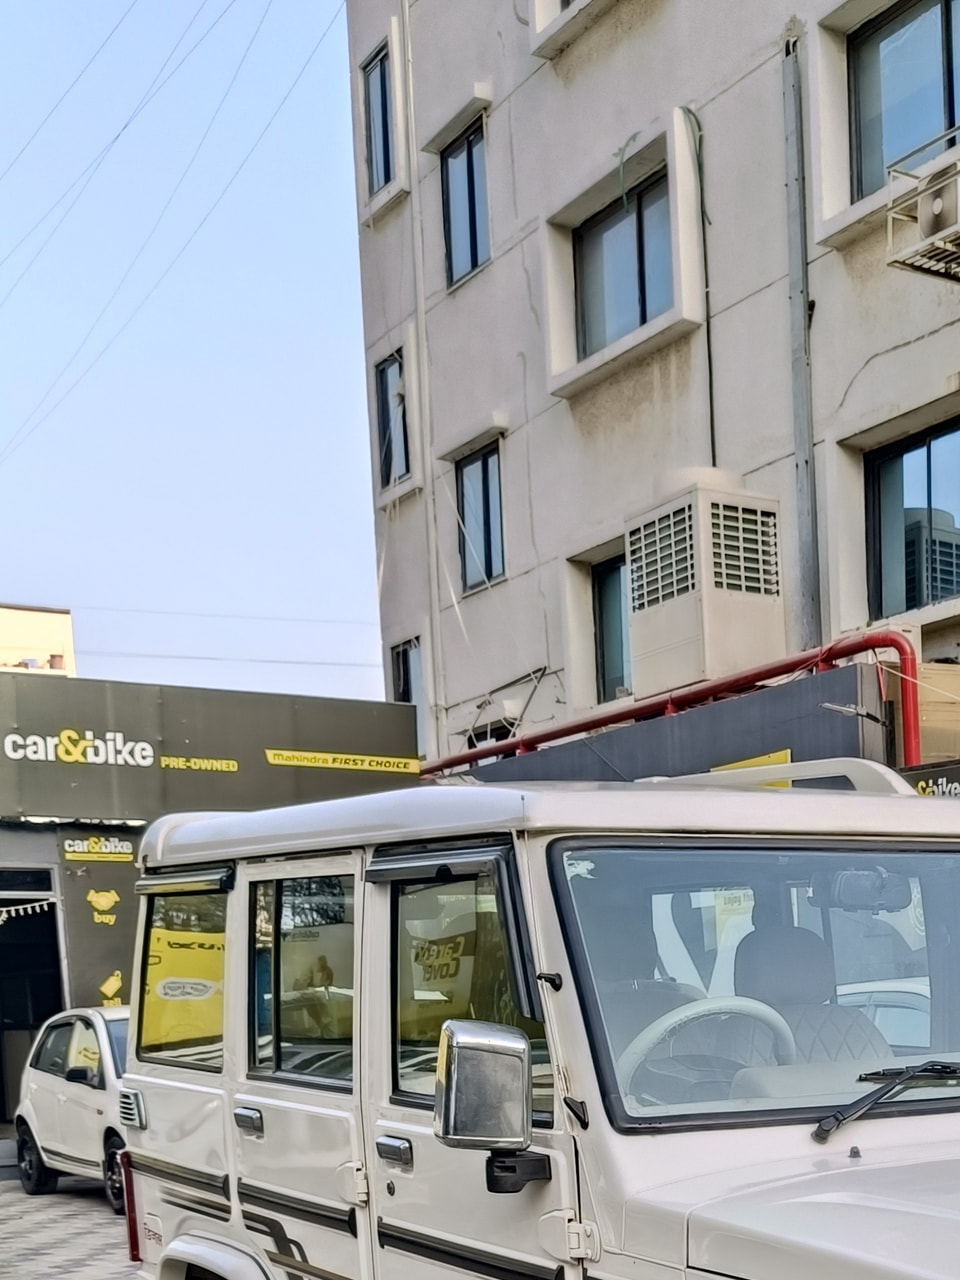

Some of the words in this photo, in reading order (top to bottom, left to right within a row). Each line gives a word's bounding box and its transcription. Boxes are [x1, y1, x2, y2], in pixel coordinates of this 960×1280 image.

[3, 729, 155, 767] car&bike
[160, 755, 239, 772] PRE-OWNED
[272, 753, 329, 765] Mahindra
[331, 757, 367, 767] FIRST
[368, 759, 410, 770] CHOICE
[64, 836, 133, 854] car&bike
[93, 911, 117, 926] buy
